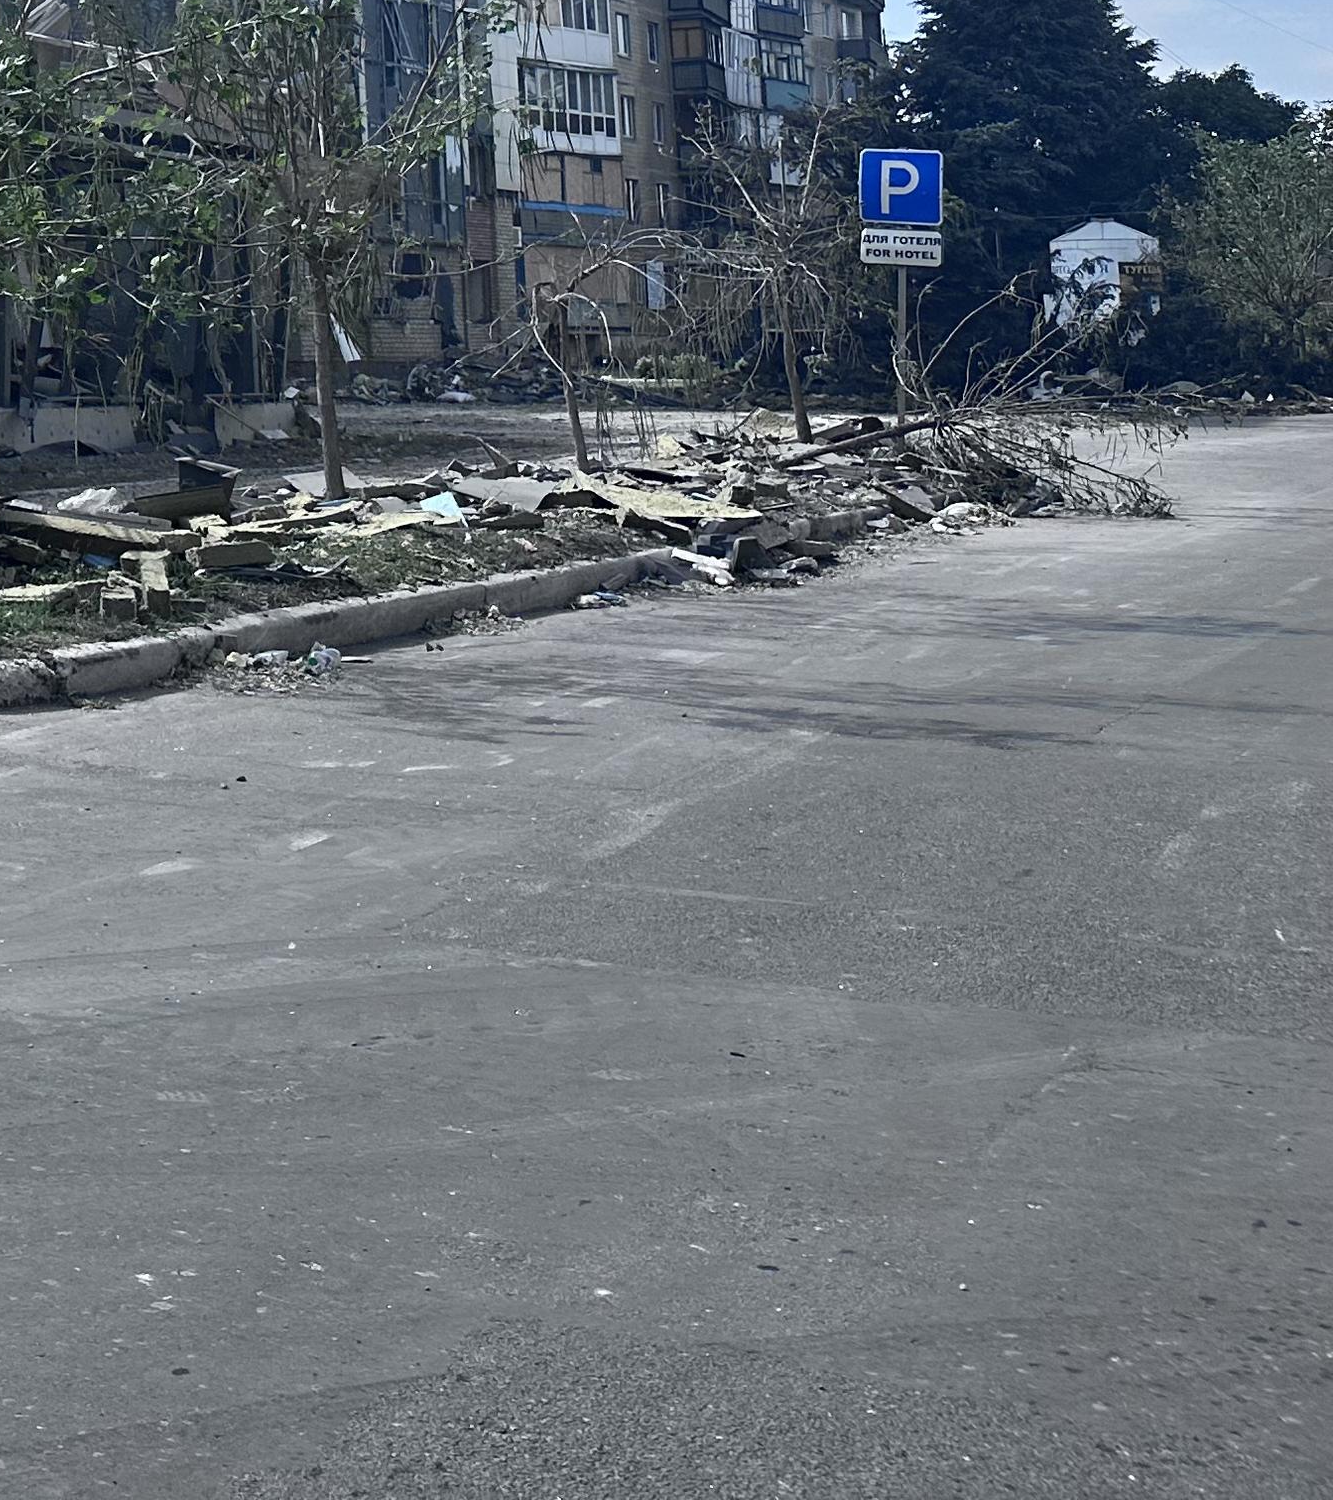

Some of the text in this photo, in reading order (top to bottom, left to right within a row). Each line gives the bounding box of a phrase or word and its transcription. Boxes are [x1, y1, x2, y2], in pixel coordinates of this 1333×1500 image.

[881, 160, 919, 214] P
[863, 234, 941, 246] ДЛЯ ГОТЕЛЯ
[866, 249, 937, 260] FOR HOTEL
